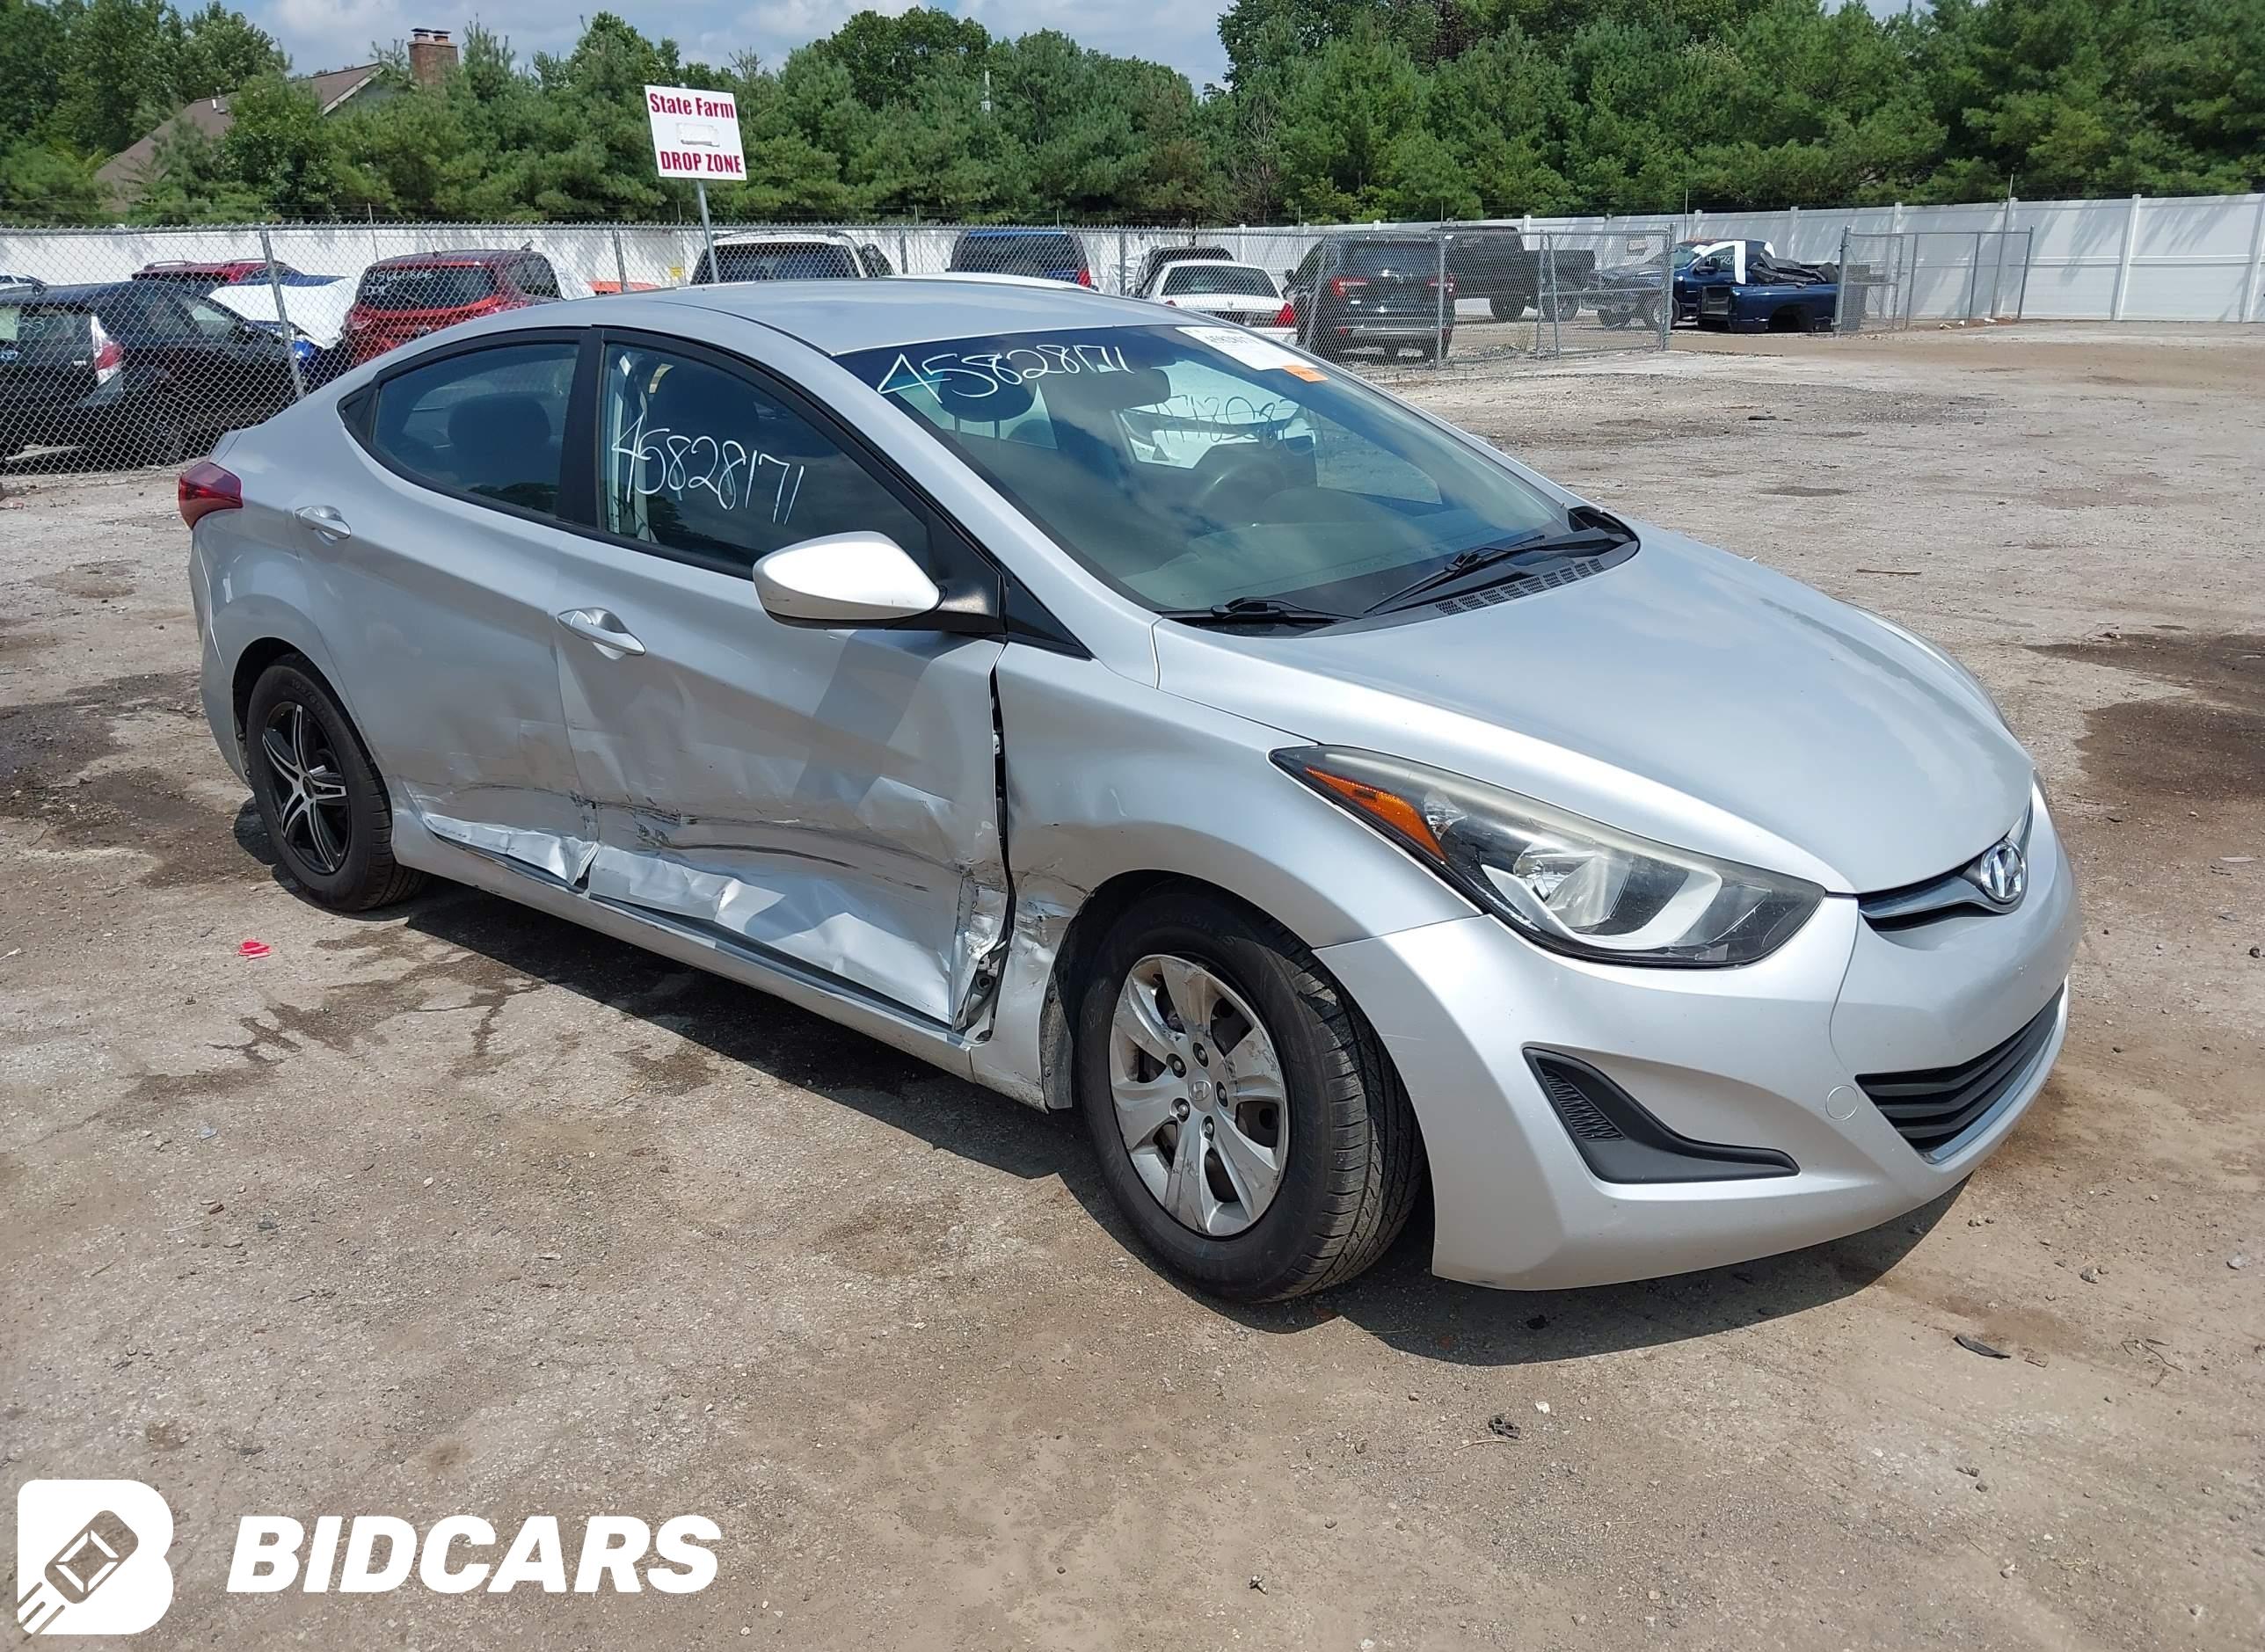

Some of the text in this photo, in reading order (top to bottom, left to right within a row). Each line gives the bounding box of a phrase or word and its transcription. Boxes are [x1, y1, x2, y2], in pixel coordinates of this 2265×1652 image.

[649, 93, 734, 119] State Farm
[660, 151, 742, 173] DROP ZONE
[878, 345, 1135, 404] 45828171
[611, 411, 805, 526] 45828171
